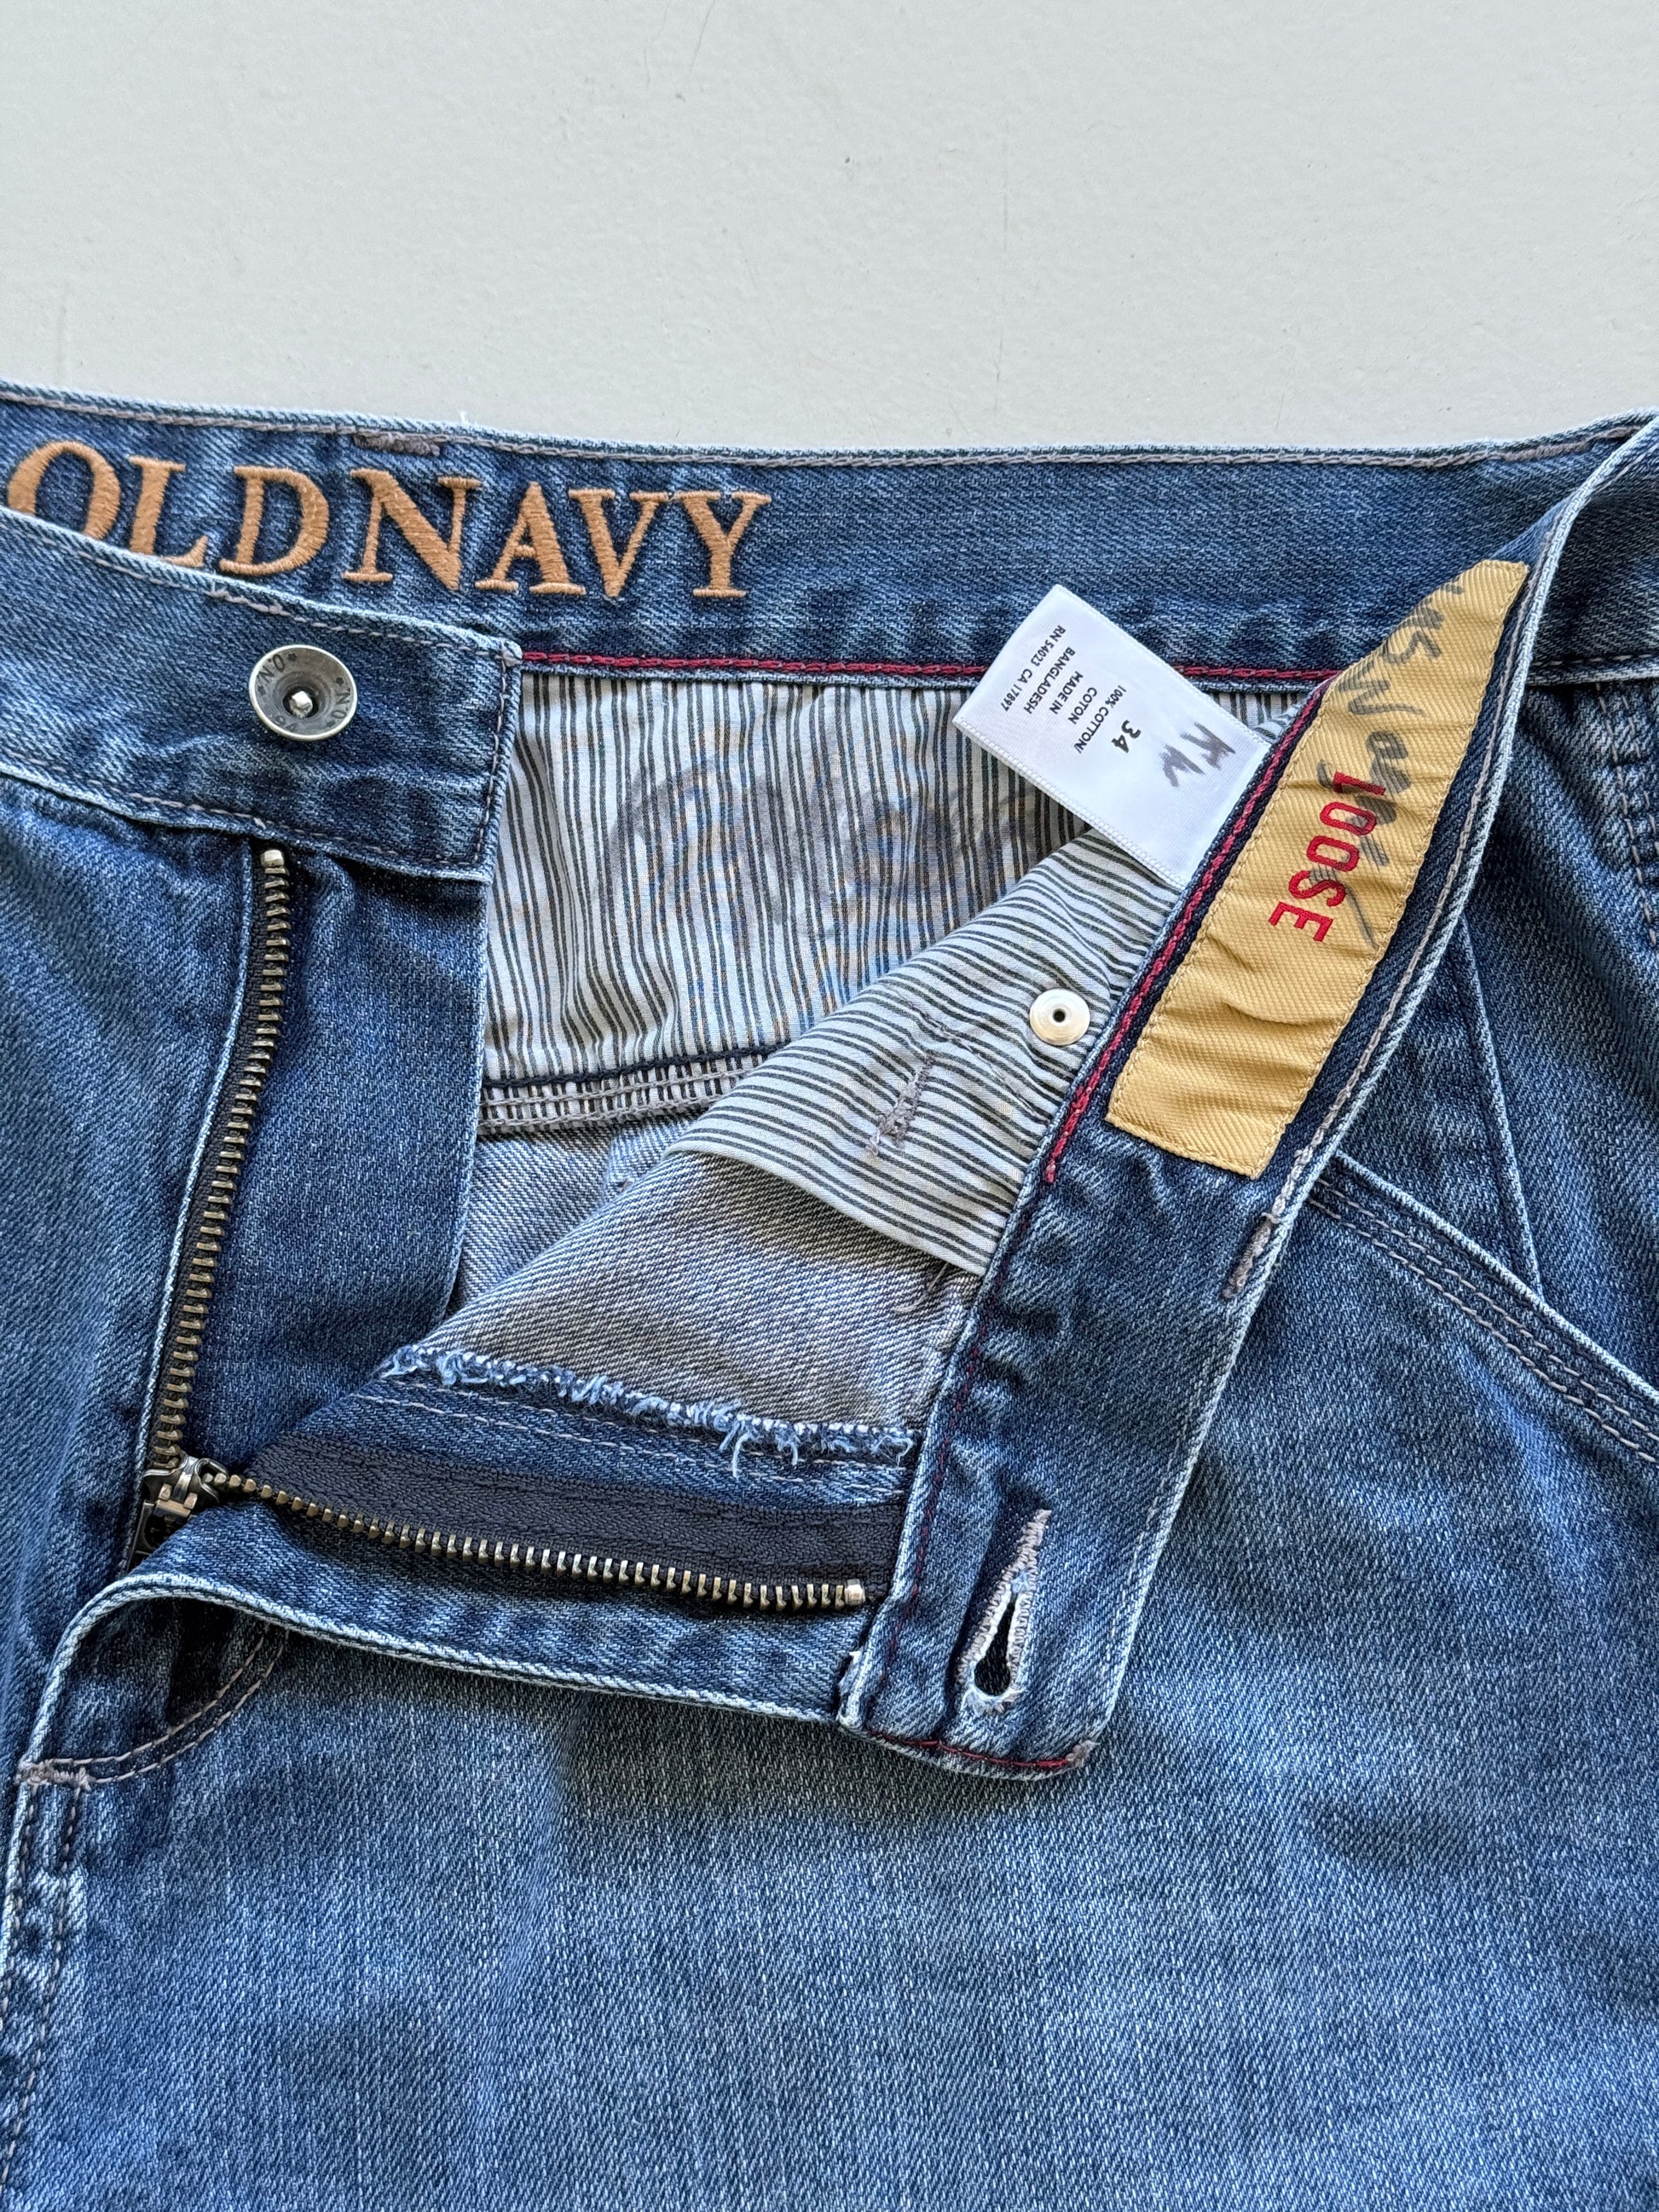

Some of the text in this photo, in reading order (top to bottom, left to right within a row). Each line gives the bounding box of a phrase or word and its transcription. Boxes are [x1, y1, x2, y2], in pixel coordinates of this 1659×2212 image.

[8, 441, 771, 598] OLD NAVY
[1001, 625, 1066, 711] RN 54023 CA 17897
[1024, 647, 1075, 713] BANGLADESH
[1049, 671, 1084, 714] MADE IN
[1068, 688, 1097, 725] COTON
[1074, 684, 1127, 754] 100% COTTON/
[1112, 720, 1141, 753] 34
[1268, 771, 1385, 943] LOOSE
